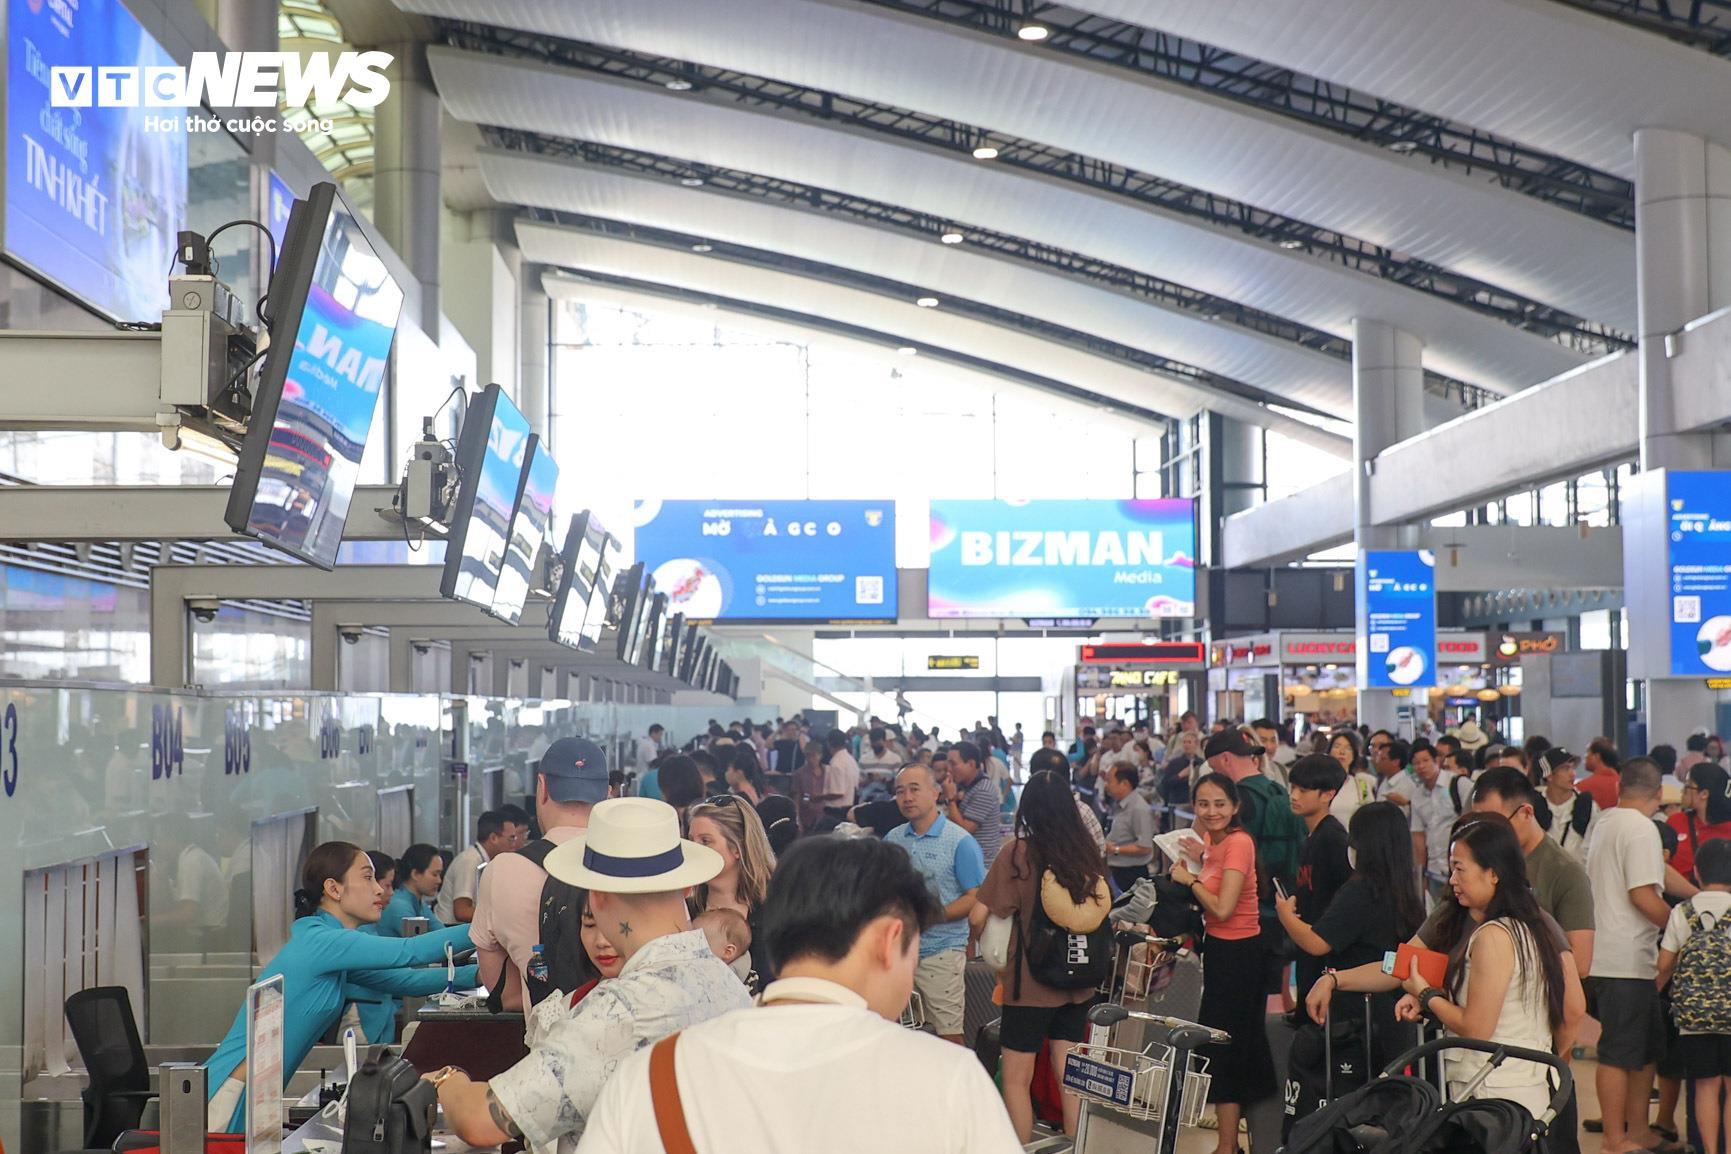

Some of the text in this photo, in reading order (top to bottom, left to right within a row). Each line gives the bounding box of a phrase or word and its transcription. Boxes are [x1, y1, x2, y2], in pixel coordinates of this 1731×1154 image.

[961, 531, 1164, 566] BIZMAN
[1114, 571, 1162, 584] Media
[1287, 641, 1335, 655] LUCKY
[152, 703, 184, 780] B04
